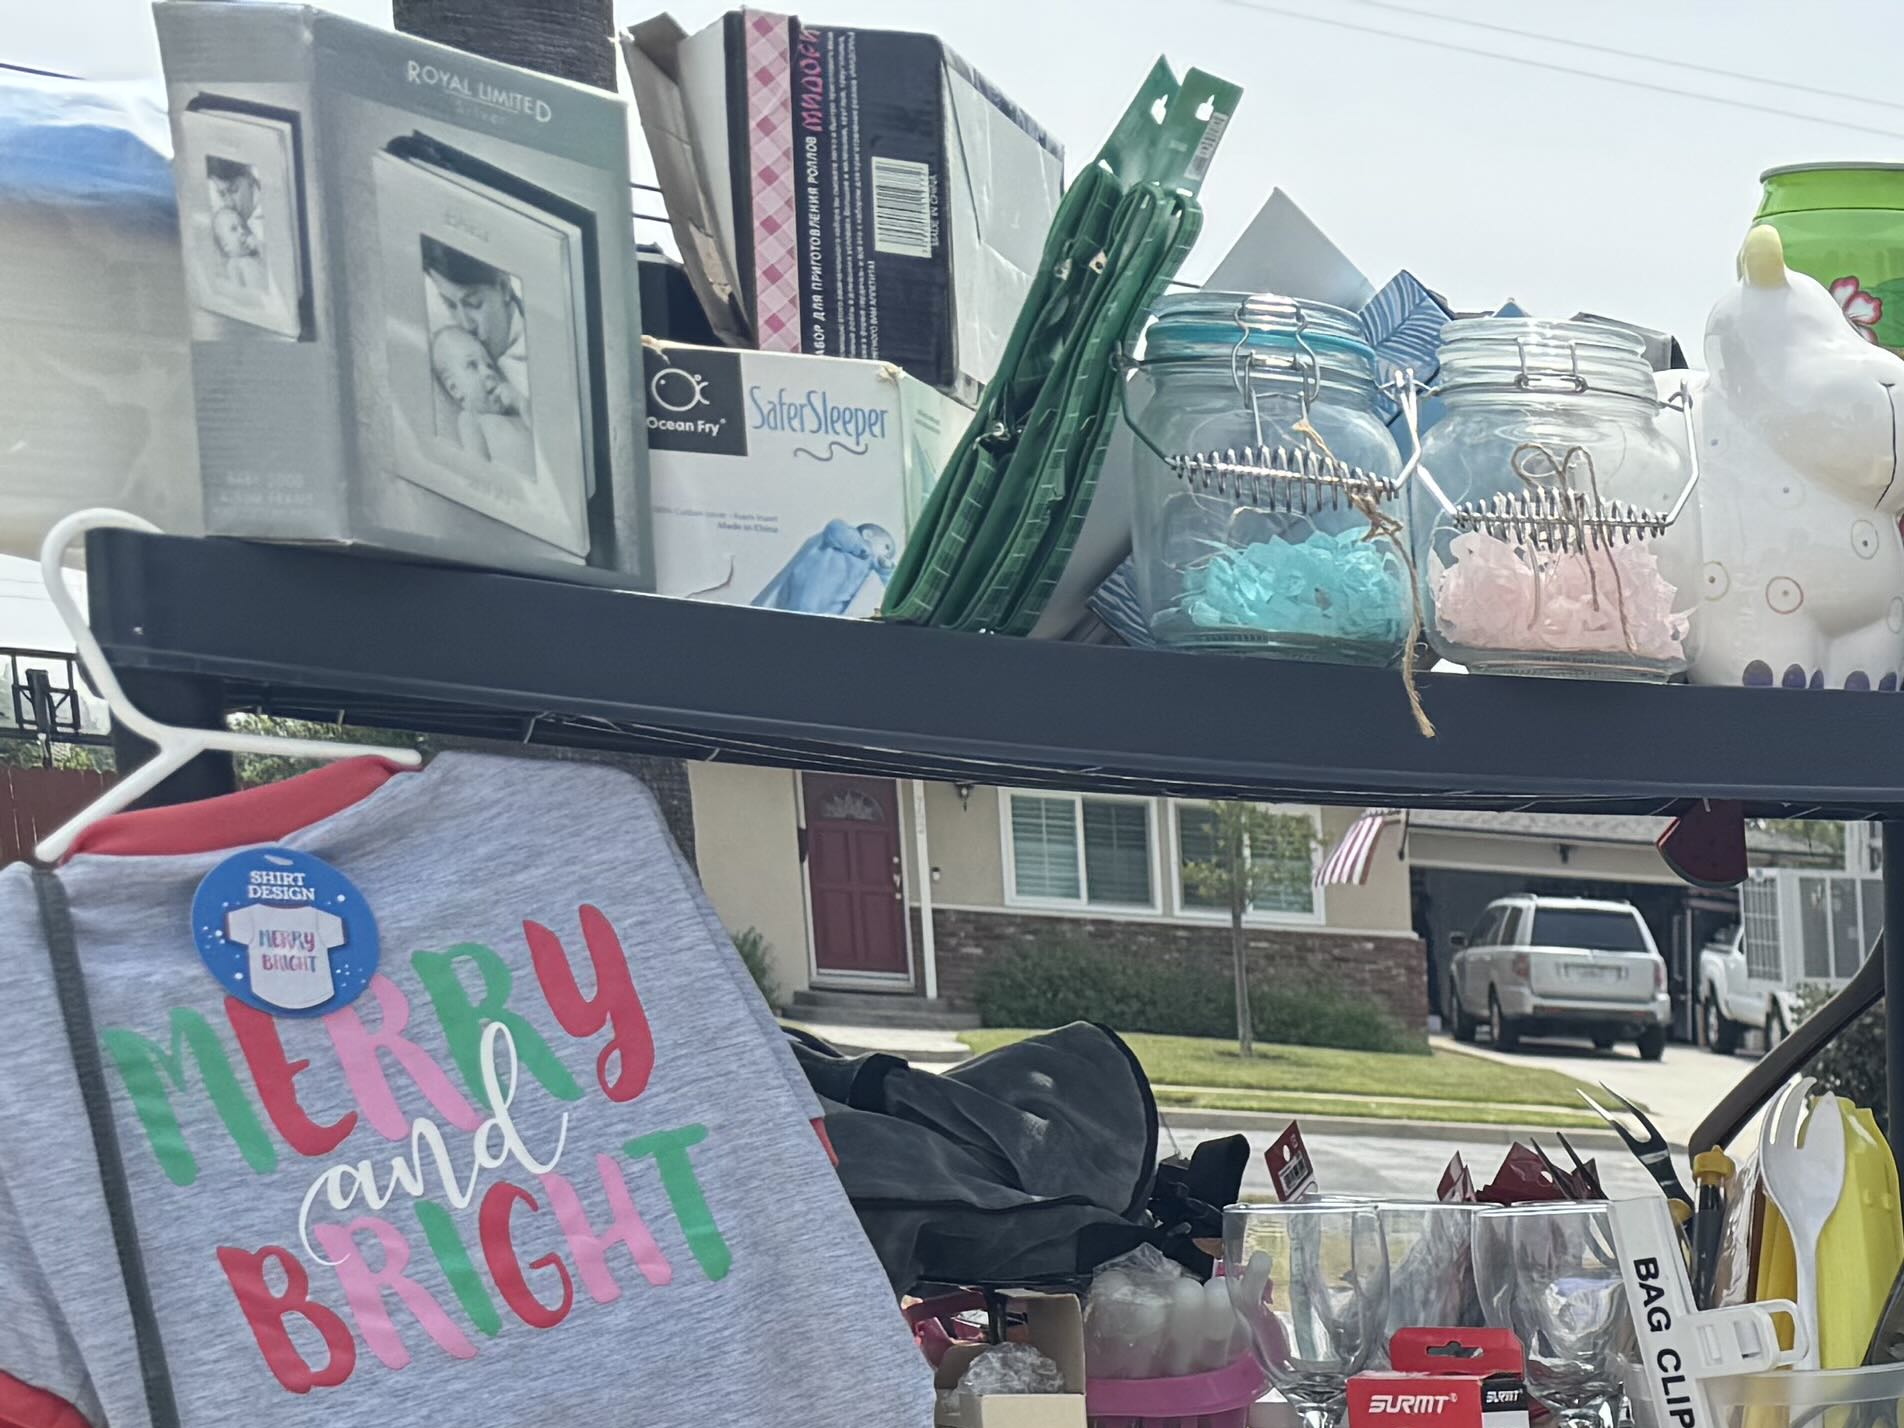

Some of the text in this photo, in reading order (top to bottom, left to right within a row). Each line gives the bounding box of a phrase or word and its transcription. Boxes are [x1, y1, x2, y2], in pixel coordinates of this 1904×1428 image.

[407, 59, 552, 123] ROYAL LIMITED
[804, 136, 819, 184] РОЛЛОВ
[646, 417, 695, 433] Ocean
[751, 385, 888, 447] SaferSleeper
[248, 885, 315, 901] DESIGN
[250, 870, 306, 886] SHIRT
[258, 930, 316, 952] MERRY
[262, 953, 318, 973] BRIGHT
[103, 904, 655, 1186] MERRY
[298, 1022, 570, 1265] and
[216, 1123, 731, 1393] BRIGHT
[1632, 1255, 1673, 1335] BAG
[1369, 1394, 1451, 1415] SURMT
